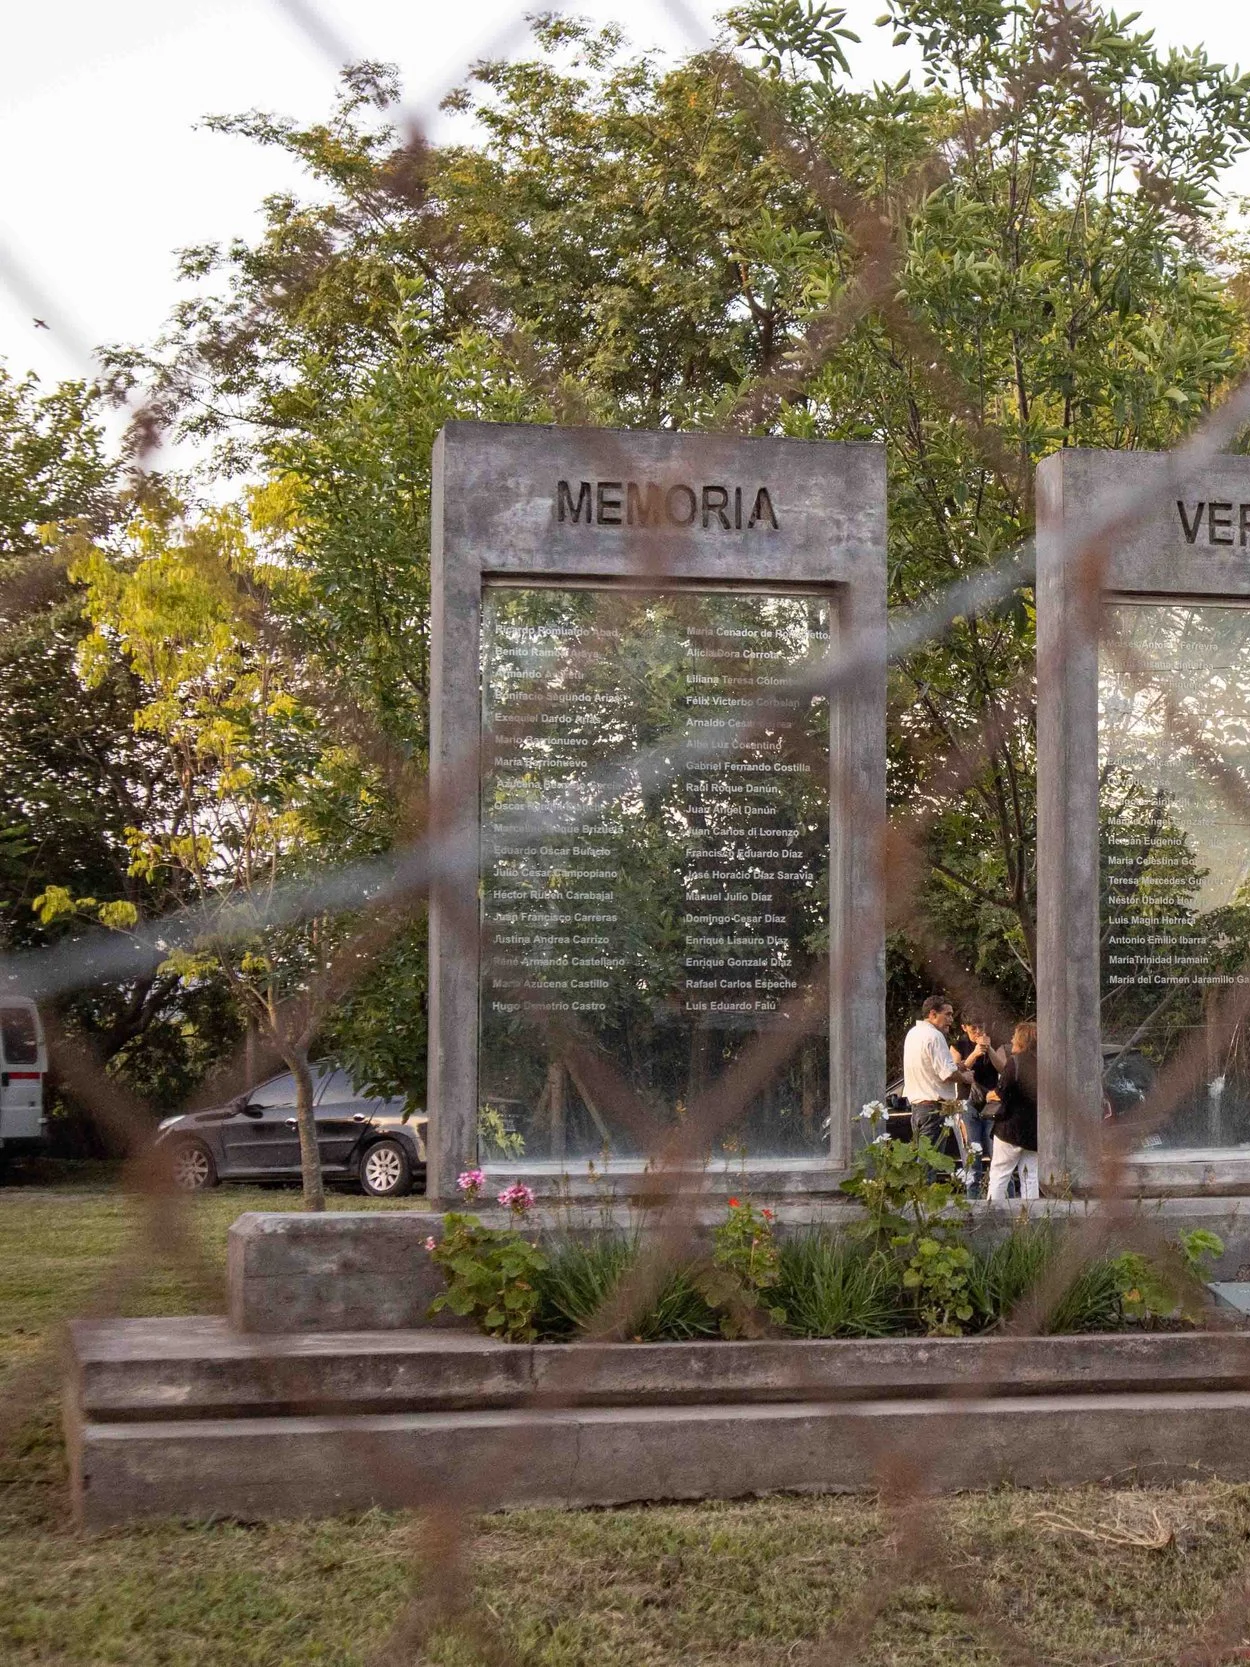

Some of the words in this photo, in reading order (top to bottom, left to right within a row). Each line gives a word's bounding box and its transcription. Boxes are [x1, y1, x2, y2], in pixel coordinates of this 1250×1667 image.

[557, 479, 779, 530] MEMORIA
[537, 625, 590, 637] Romualdo
[716, 627, 759, 637] Cenador
[495, 646, 529, 656] Benito
[686, 648, 718, 657] Alicia
[686, 674, 719, 684] Liliana
[721, 675, 755, 685] Teresa
[494, 691, 544, 701] Bonifacio
[546, 691, 591, 703] Segundo
[494, 712, 538, 723] Exequiel
[541, 713, 572, 723] Dardo
[686, 718, 725, 728] Arnaldo
[525, 736, 589, 746] Barrionuevo
[731, 739, 783, 750] Cosentino
[524, 758, 588, 768] Barrionuevo
[685, 761, 722, 771] Gabriel
[724, 762, 771, 772] Fernando
[773, 763, 811, 772] Costilla
[711, 783, 743, 793] Roque
[745, 783, 778, 793] Danún
[494, 801, 525, 810] Oscar
[686, 804, 711, 814] Juan
[744, 805, 777, 815] Danún
[713, 827, 745, 836] Carlos
[759, 827, 800, 837] Lorenzo
[1143, 836, 1182, 847] Eugenio
[493, 846, 537, 855] Eduardo
[539, 846, 570, 855] Oscar
[572, 847, 611, 856] Bulacio
[685, 848, 734, 858] Francisco
[737, 849, 779, 858] Eduardo
[781, 849, 804, 859] Díaz
[1136, 856, 1179, 865] Celestina
[493, 868, 519, 877] Julio
[554, 868, 618, 880] Campopiano
[712, 870, 751, 880] Horacio
[777, 871, 814, 880] Saravia
[1108, 876, 1140, 885] Teresa
[1141, 876, 1186, 885] Mercedes
[493, 889, 527, 899] Héctor
[565, 890, 614, 902] Carabajal
[685, 892, 722, 901] Manuel
[724, 892, 749, 901] Julio
[751, 892, 773, 901] Díaz
[1141, 895, 1175, 905] Ubaldo
[492, 912, 518, 921] Juan
[520, 912, 571, 922] Francisco
[573, 912, 618, 922] Carreras
[685, 913, 731, 924] Domingo
[764, 913, 787, 923] Díaz
[1108, 916, 1129, 925] Luis
[1161, 916, 1196, 925] Herrera
[493, 934, 531, 944] Justina
[533, 934, 571, 944] Andrea
[572, 935, 610, 944] Carrizo
[685, 936, 725, 946] Enrique
[727, 936, 765, 945] Lisauro
[1108, 935, 1146, 945] Antonio
[1147, 935, 1177, 945] Emilio
[1179, 936, 1207, 945] Ibarra
[520, 957, 569, 966] Armando
[570, 957, 625, 966] Castellano
[685, 957, 725, 968] Enrique
[727, 957, 768, 967] Gonzalo
[1174, 955, 1209, 964] Iramain
[523, 979, 567, 988] Azucena
[570, 979, 609, 988] Castillo
[685, 979, 717, 988] Rafael
[719, 979, 752, 989] Carlos
[754, 980, 798, 990] Espeche
[1137, 975, 1152, 985] del
[1154, 975, 1190, 985] Carmen
[1192, 975, 1234, 985] Jaramillo
[492, 1001, 521, 1012] Hugo
[523, 1001, 569, 1010] Demetrio
[571, 1001, 607, 1011] Castro
[685, 1001, 708, 1010] Luis
[710, 1001, 753, 1010] Eduardo
[754, 1001, 776, 1011] Falú
